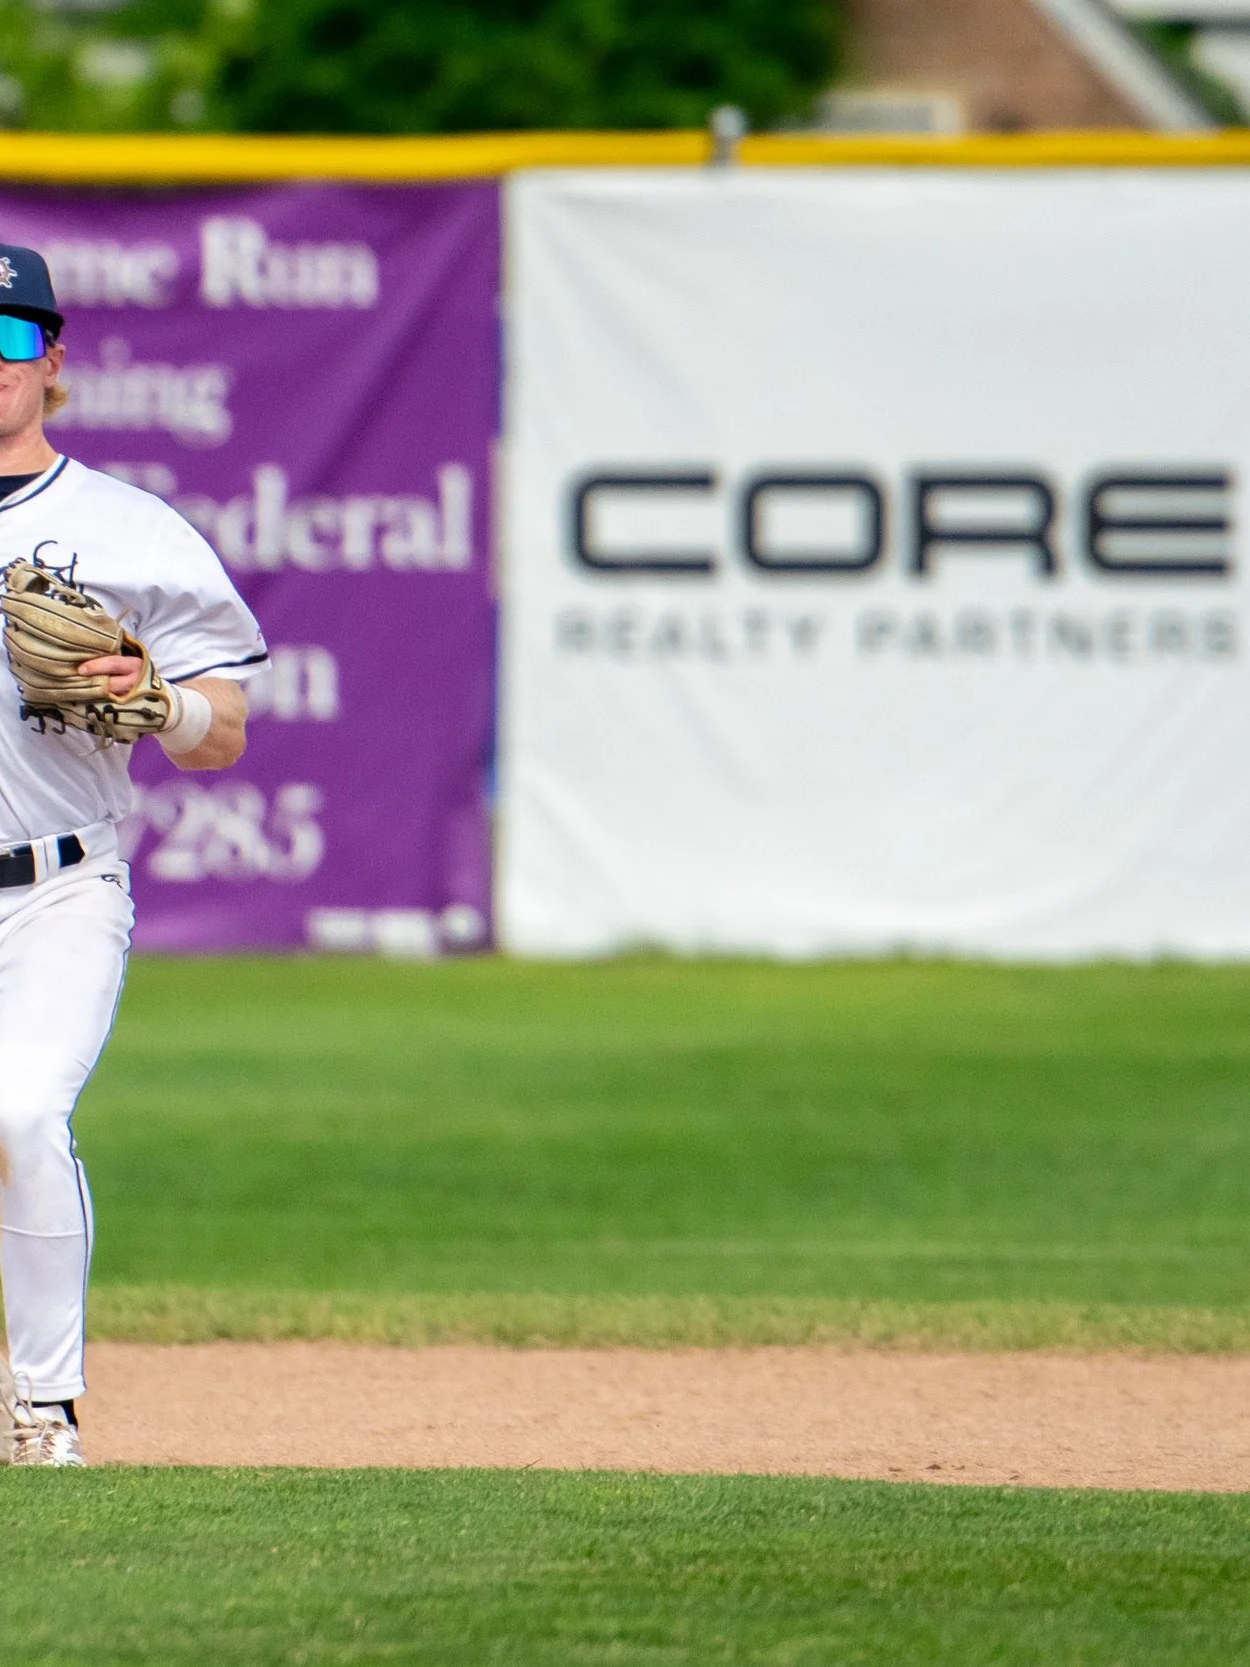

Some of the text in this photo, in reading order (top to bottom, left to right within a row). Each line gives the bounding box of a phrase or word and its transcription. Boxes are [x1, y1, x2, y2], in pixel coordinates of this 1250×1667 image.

[200, 215, 379, 309] Run
[565, 461, 1236, 580] CORE
[555, 608, 1240, 659] REALTY PARTNERS
